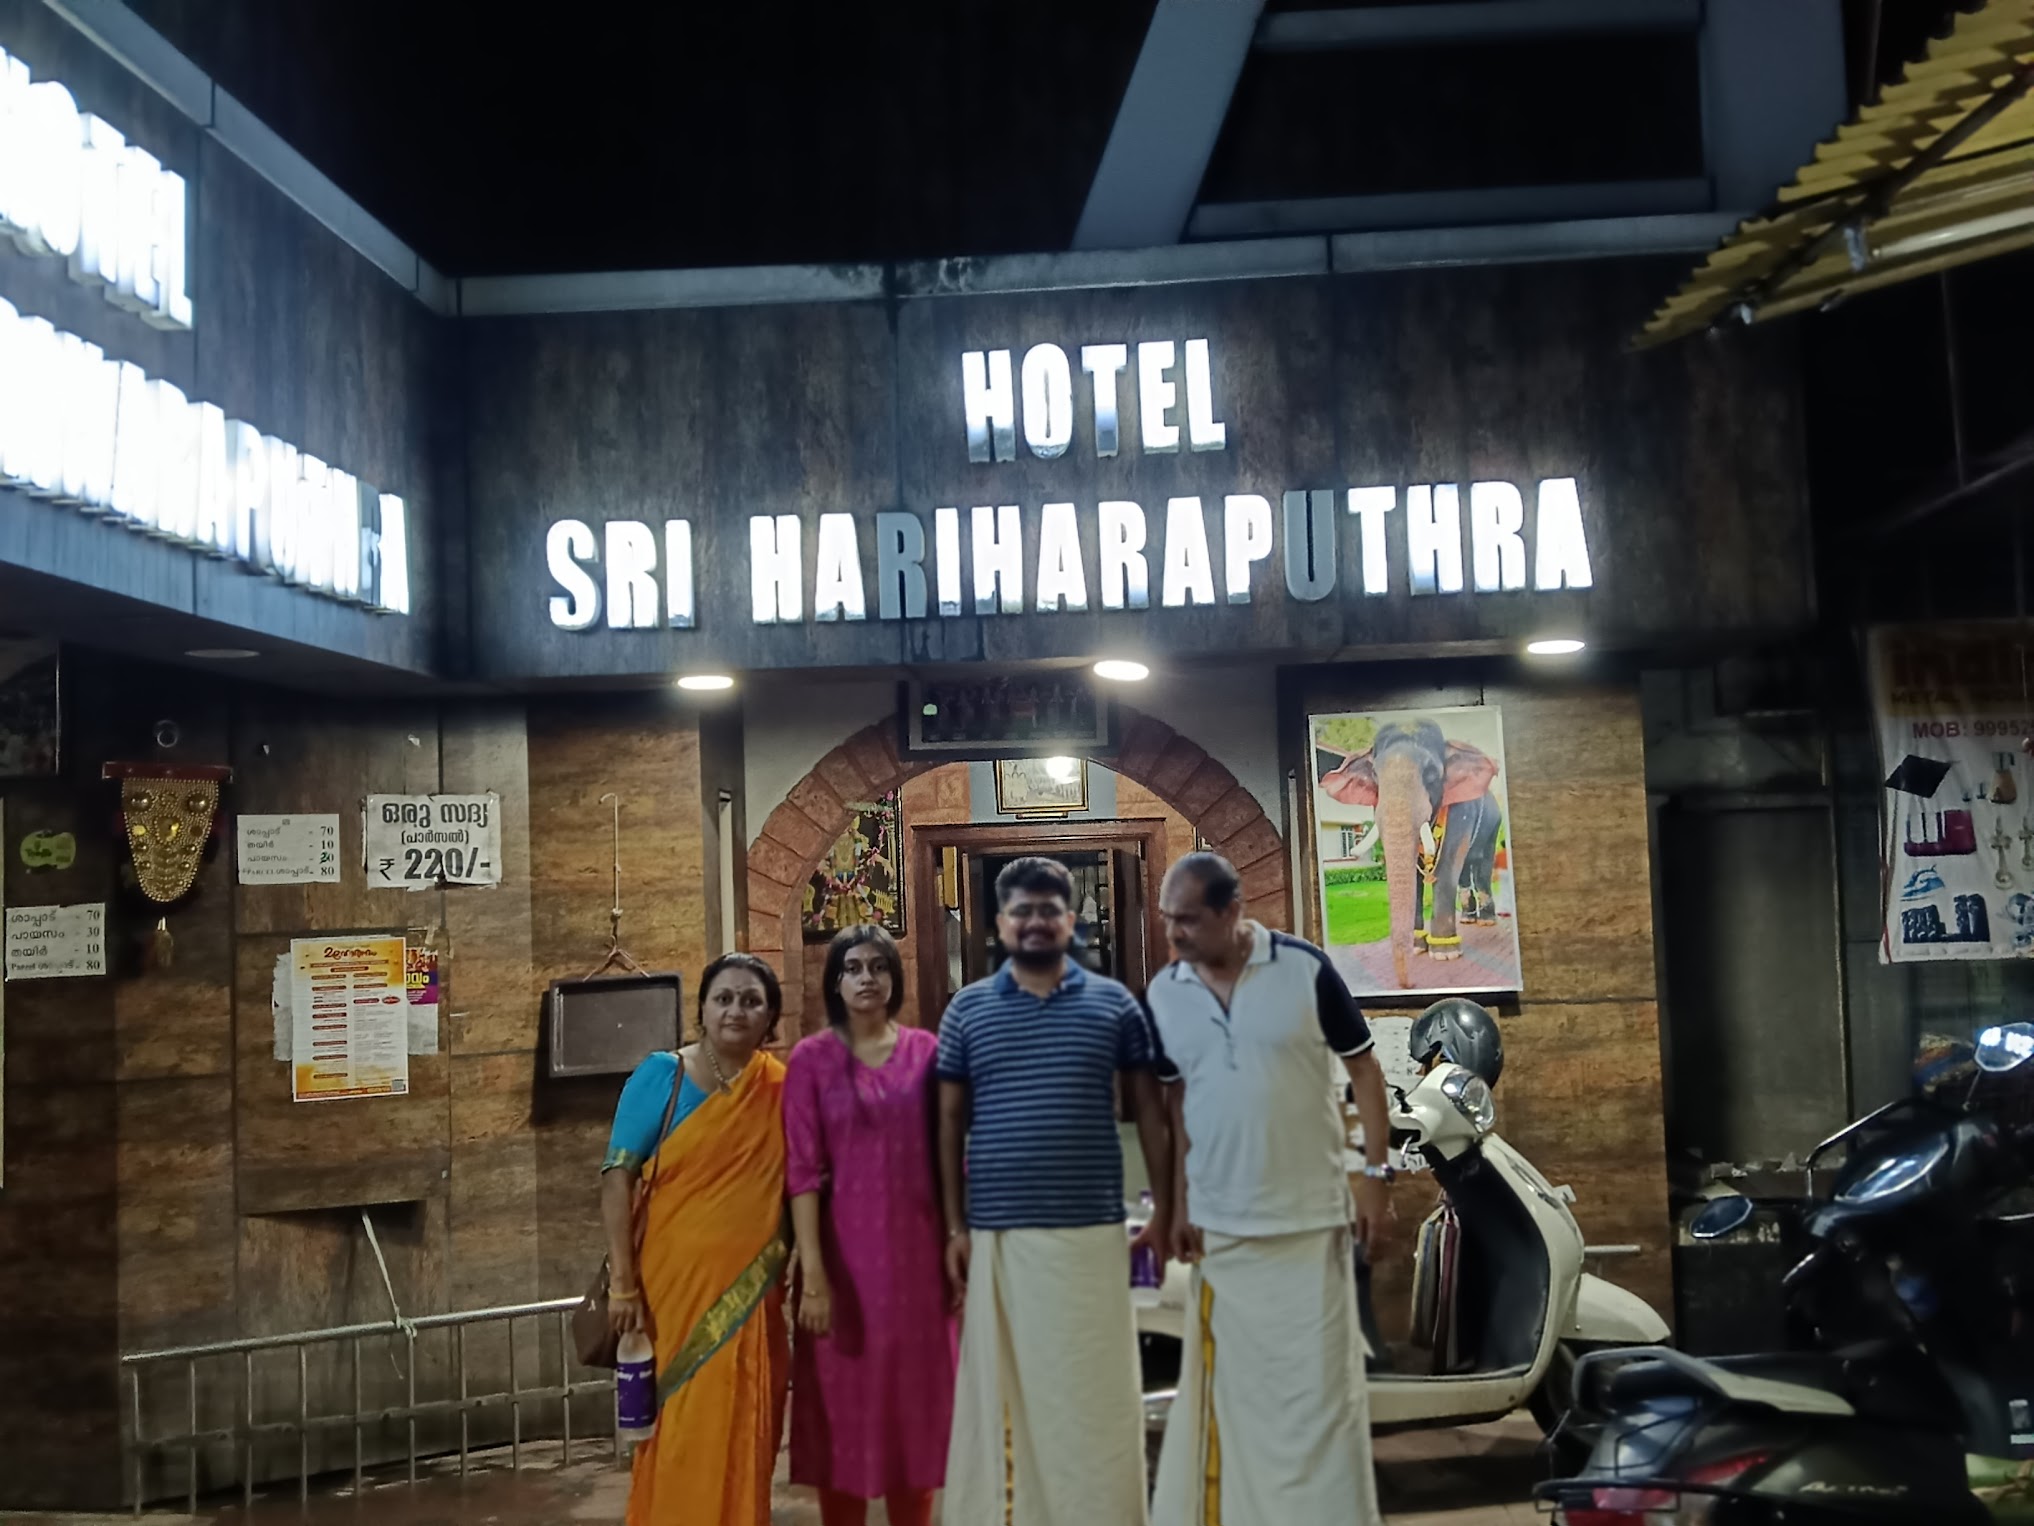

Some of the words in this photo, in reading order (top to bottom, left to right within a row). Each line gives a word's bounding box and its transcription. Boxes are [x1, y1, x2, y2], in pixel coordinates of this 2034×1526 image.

[961, 337, 1227, 463] HOTEL
[545, 517, 697, 632] SRI
[749, 477, 1594, 626] HARIHARAPUTHRA
[382, 802, 432, 828] ഒരു
[440, 802, 489, 828] സദ്യ
[320, 826, 334, 836] 70
[320, 840, 334, 850] 10
[320, 866, 335, 876] 80
[86, 909, 100, 921] 70
[86, 927, 100, 938] 30
[86, 943, 100, 955] 10
[86, 960, 100, 971] 80
